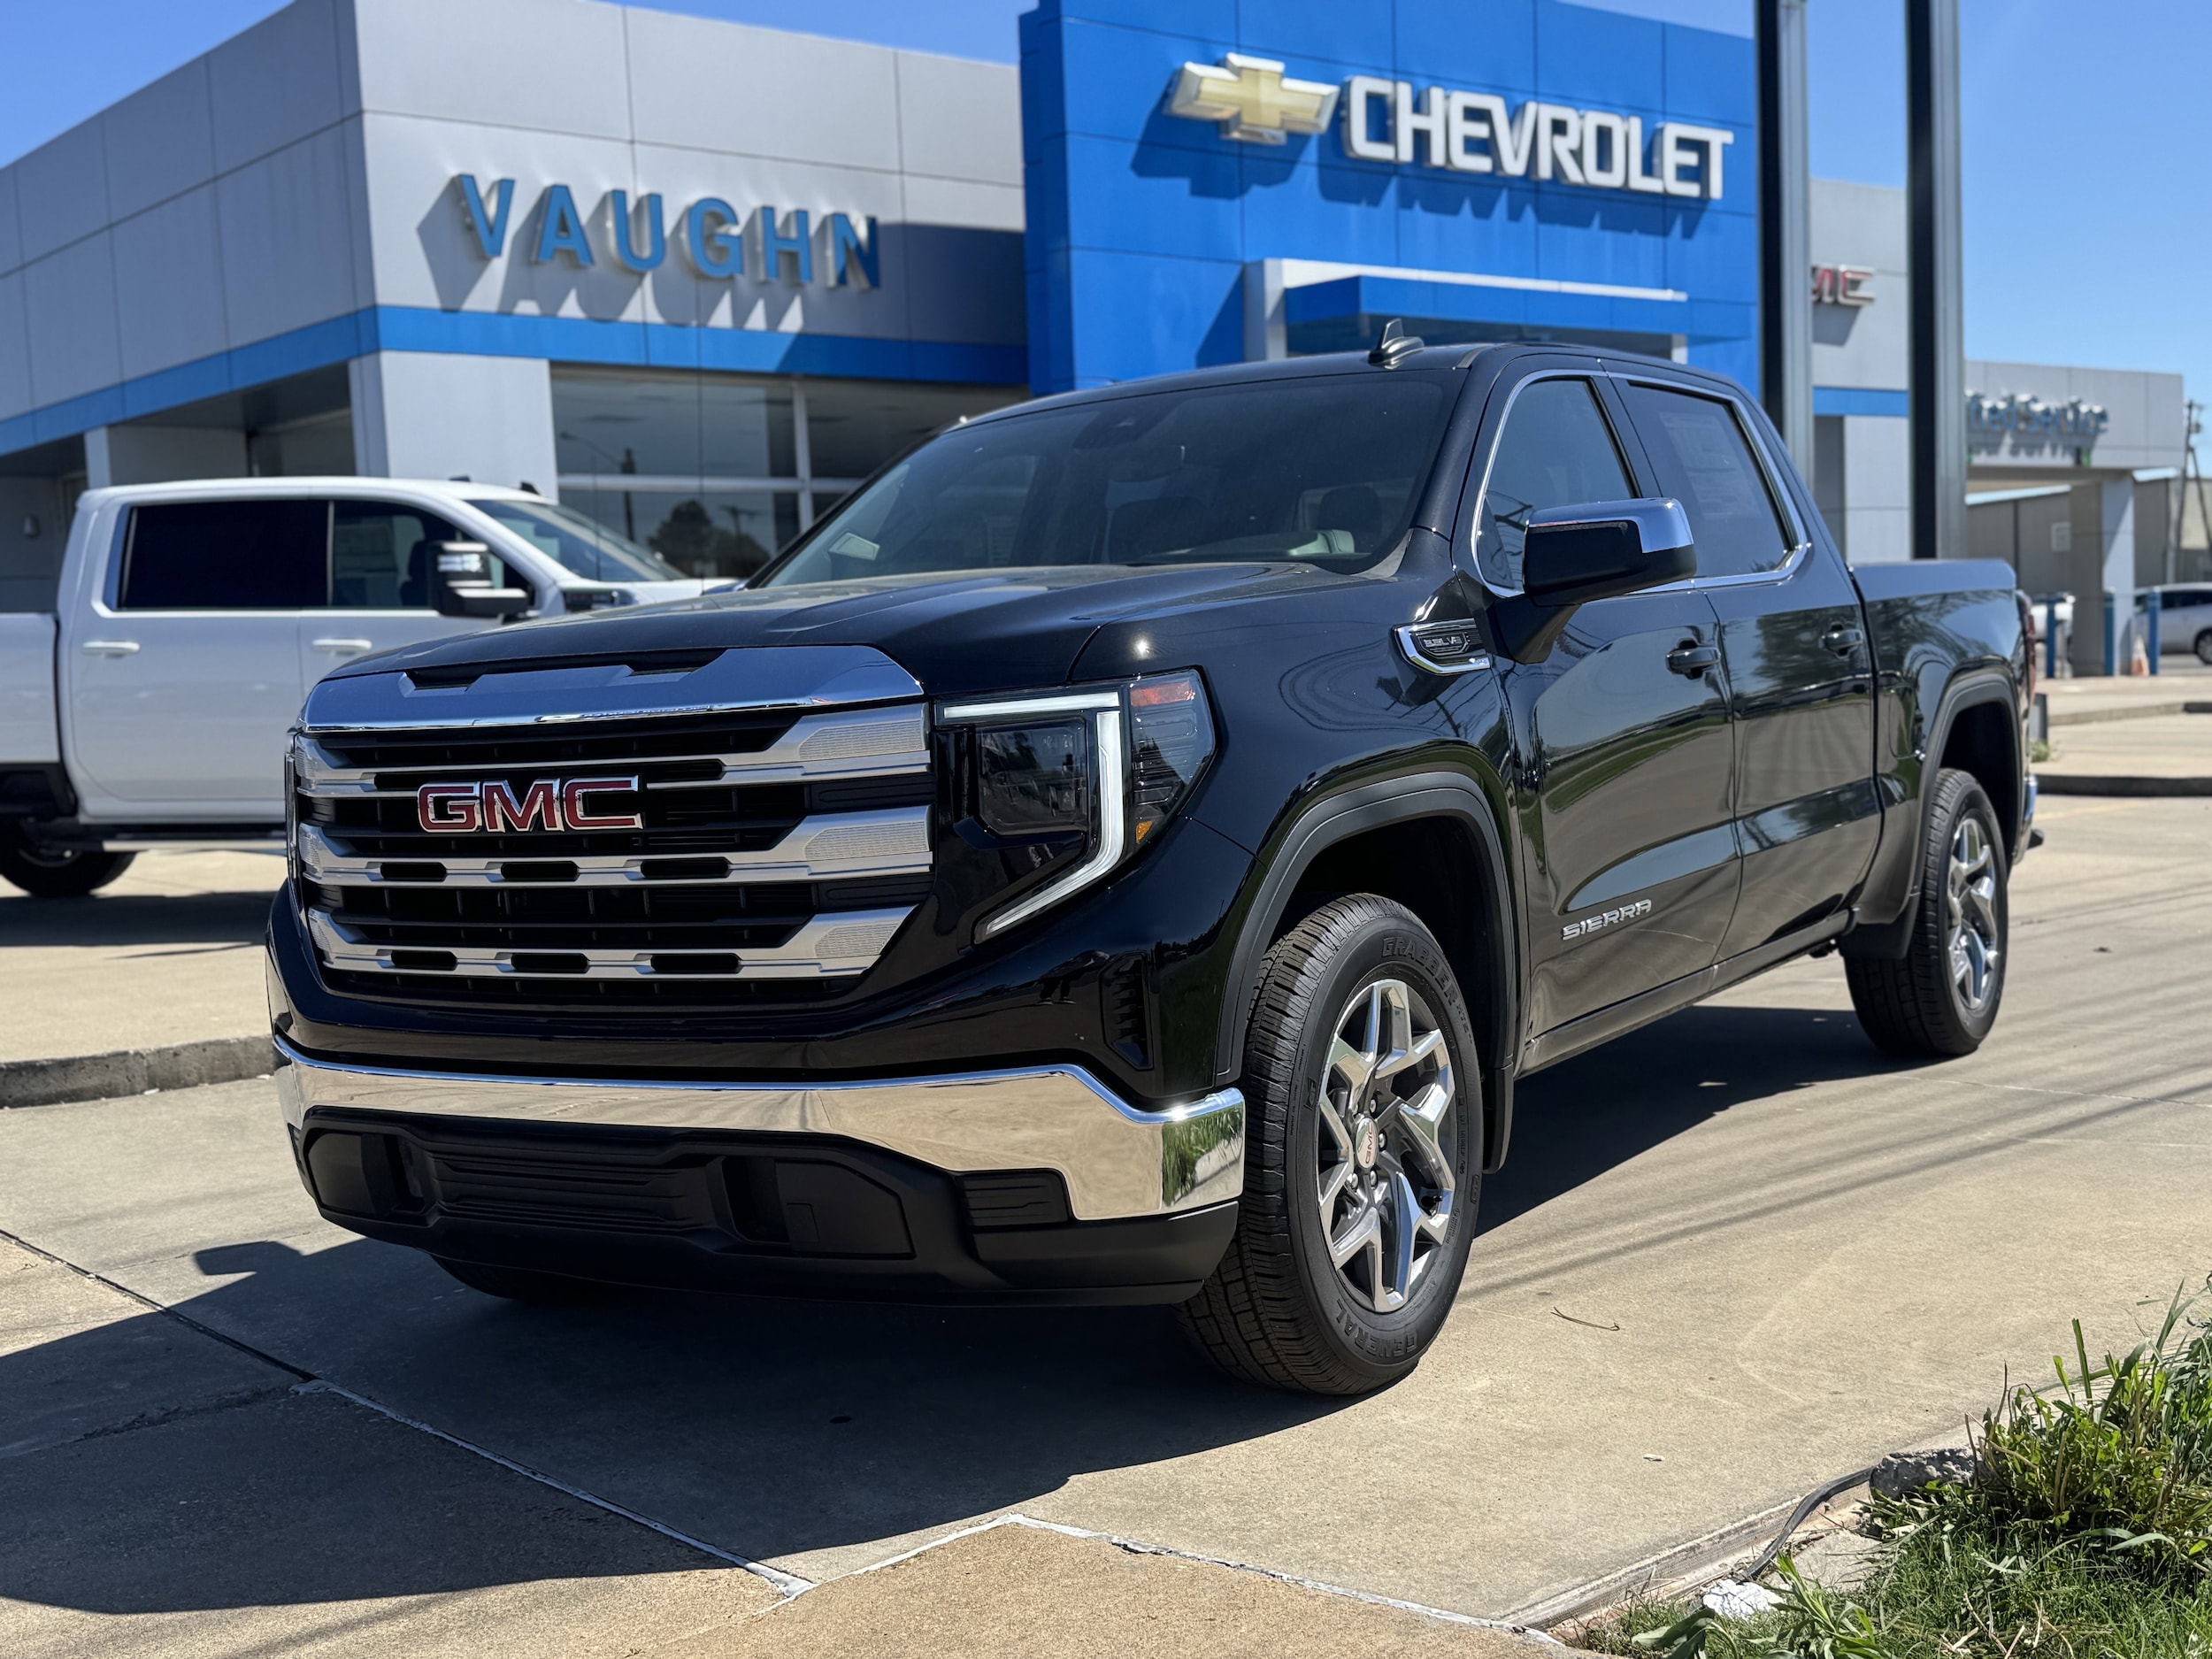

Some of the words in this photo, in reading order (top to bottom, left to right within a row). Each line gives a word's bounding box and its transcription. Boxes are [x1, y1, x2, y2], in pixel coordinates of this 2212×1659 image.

[1343, 74, 1734, 200] CHEVROLET
[453, 173, 880, 289] VAUGHN
[1811, 265, 1875, 306] MC
[417, 774, 643, 833] GMC
[1562, 898, 1652, 941] SIERRA
[1381, 936, 1459, 1006] GRABBER
[1335, 1298, 1417, 1359] GENERAL
